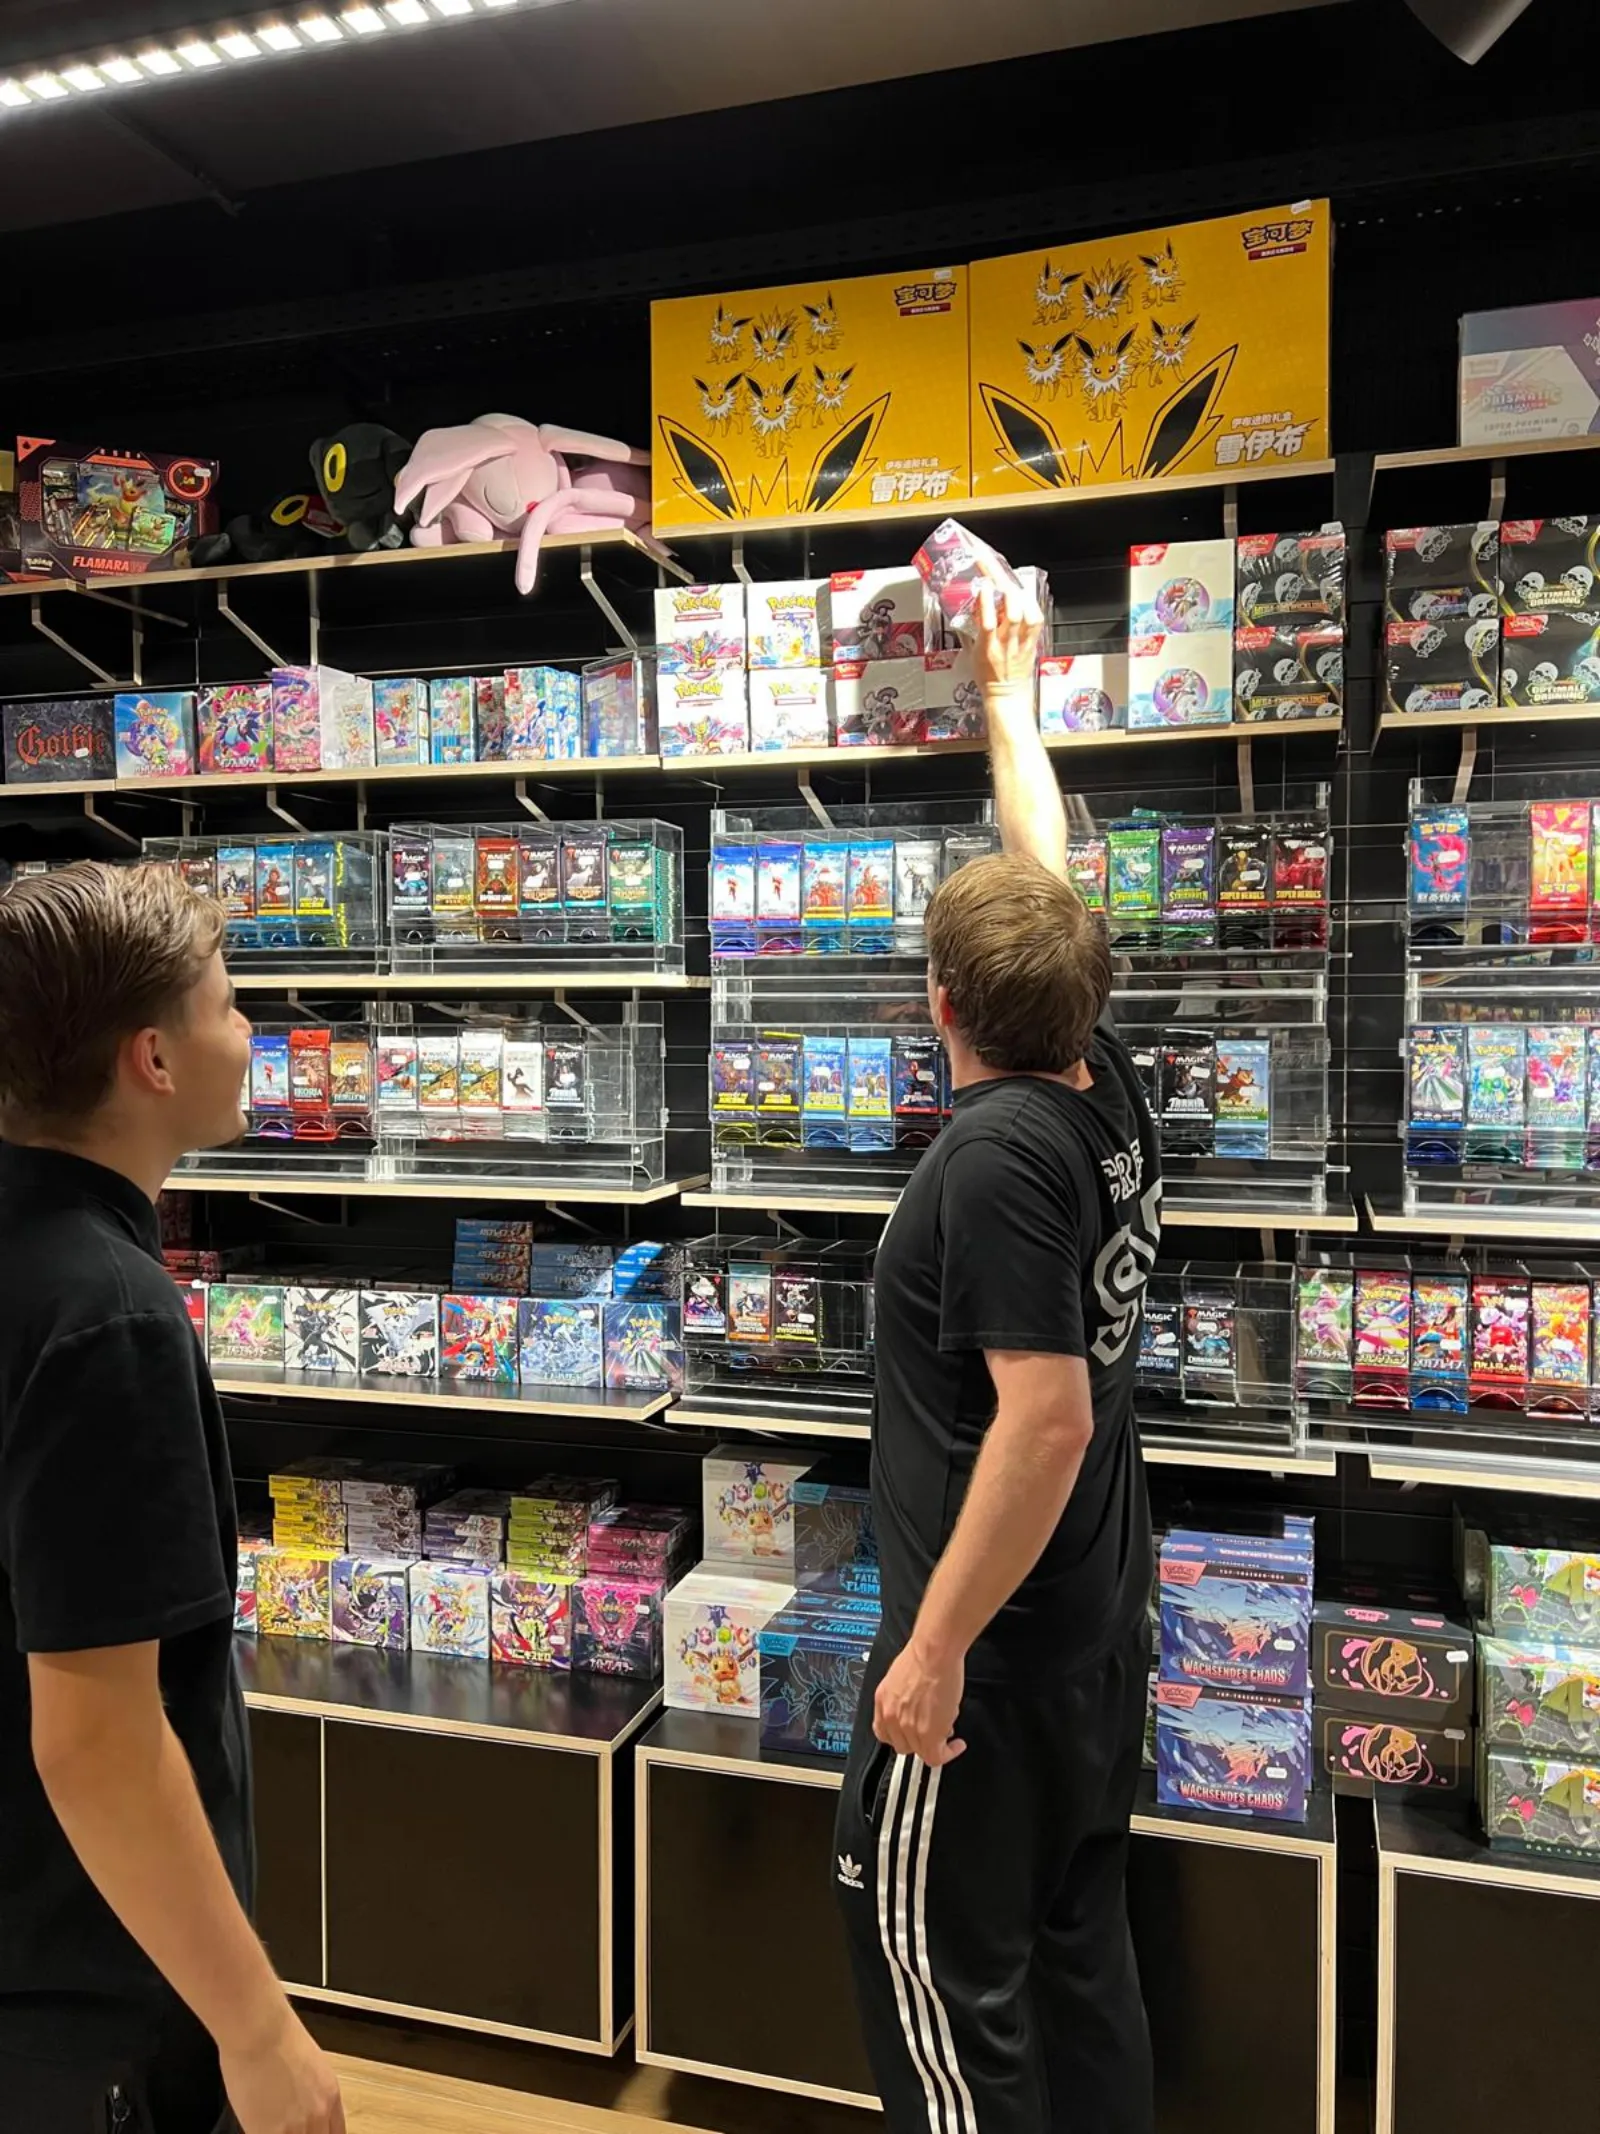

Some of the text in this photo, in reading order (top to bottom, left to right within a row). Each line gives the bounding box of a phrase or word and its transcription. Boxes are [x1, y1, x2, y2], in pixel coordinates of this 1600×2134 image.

[1241, 220, 1313, 249] 宝可梦
[894, 283, 957, 306] 宝可梦
[1215, 421, 1312, 466] 雷伊布
[871, 467, 957, 504] 雷伊布
[73, 555, 129, 573] FLAMARA
[1528, 590, 1585, 600] OPTIMALE
[1532, 683, 1587, 693] OPTIMALE
[16, 723, 106, 767] Gothic
[576, 848, 600, 856] MAGIC
[1121, 847, 1151, 855] MAGIC
[1177, 844, 1208, 852] MAGIC
[530, 850, 555, 858] MAGIC
[621, 850, 645, 858] MAGIC
[1220, 891, 1240, 900] SUPER
[1276, 890, 1297, 899] SUPER
[1144, 1313, 1173, 1321] MAGIC
[1197, 1310, 1228, 1319] MAGIC
[855, 1573, 879, 1583] FATA
[1182, 1658, 1286, 1684] WACHSENDES CHAOS
[827, 1731, 851, 1742] FATA
[1180, 1780, 1284, 1810] WACHSENDES CHAOS
[838, 1873, 865, 1889] adidas
